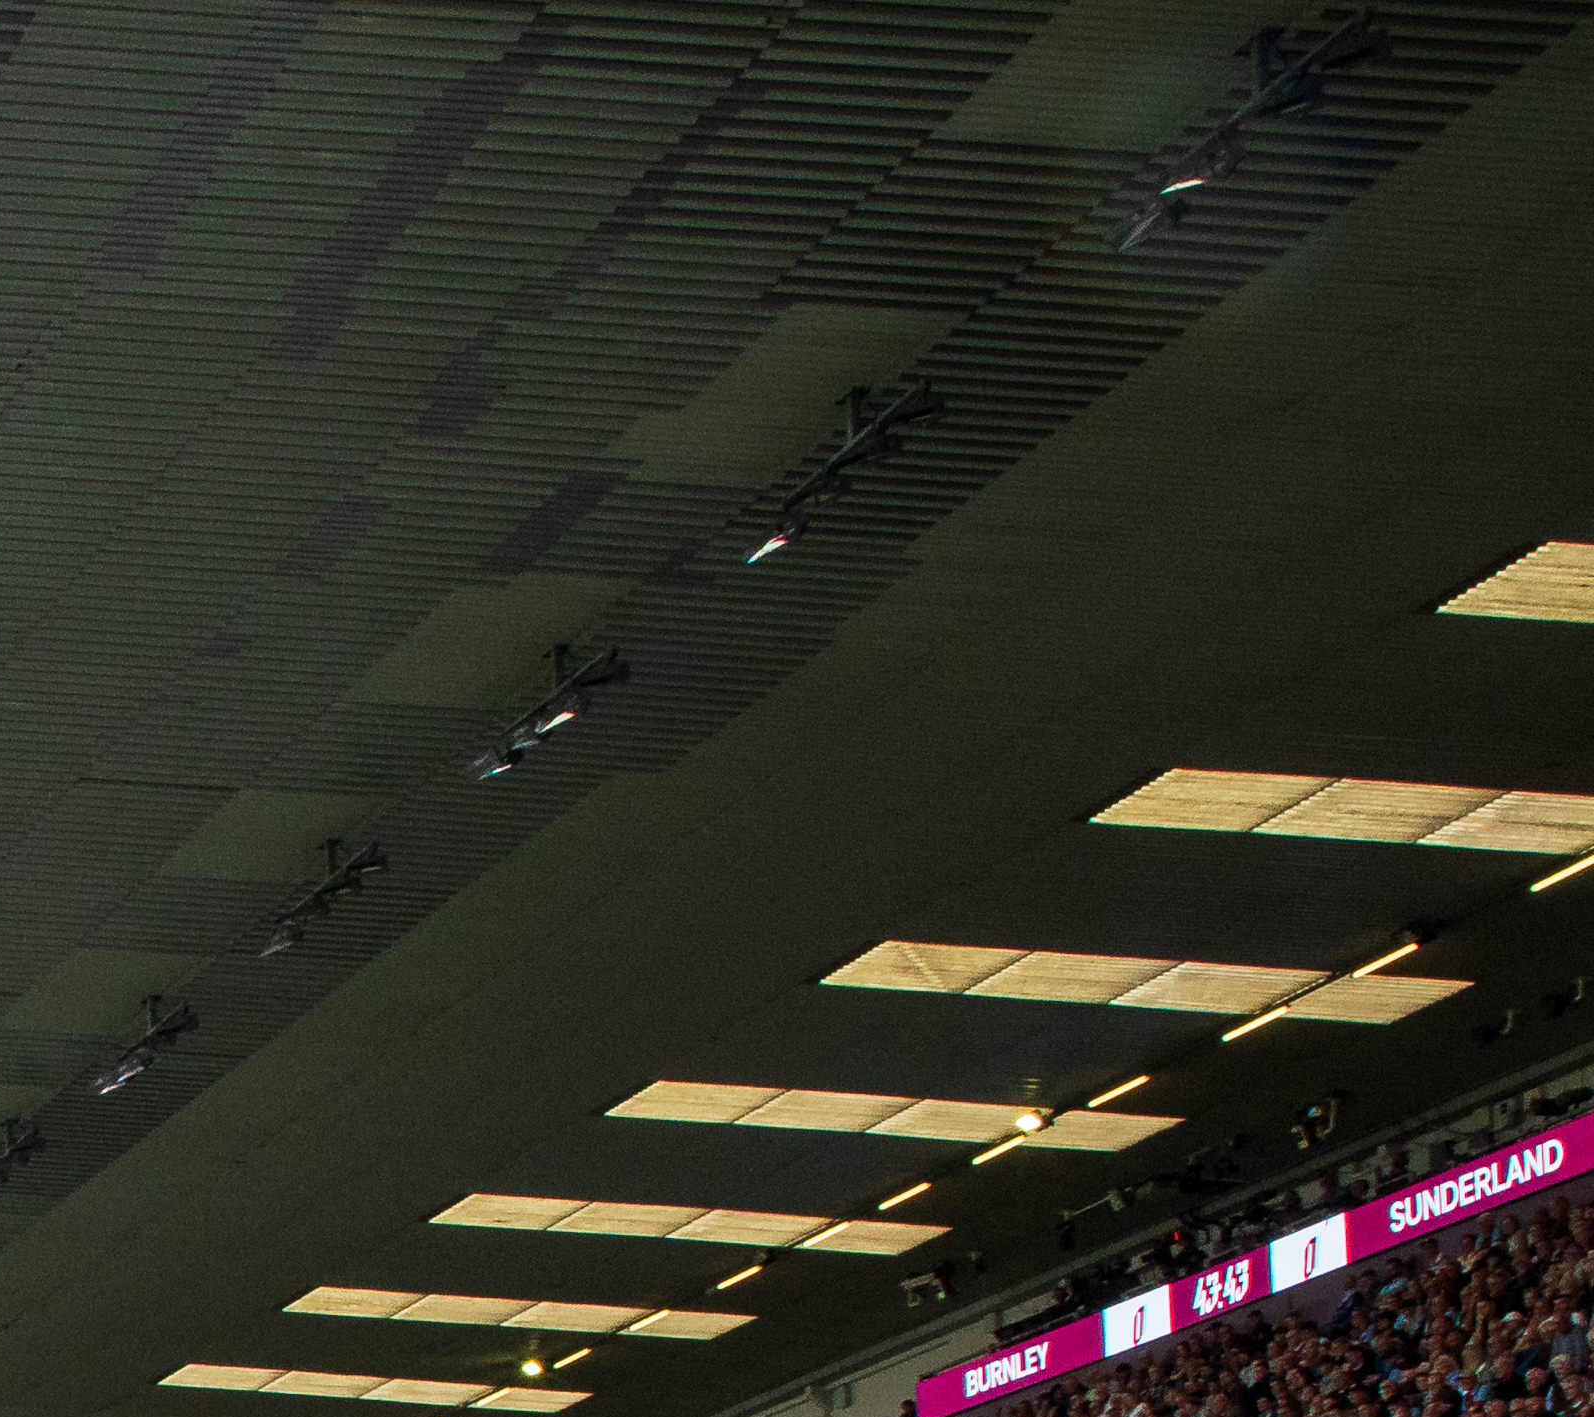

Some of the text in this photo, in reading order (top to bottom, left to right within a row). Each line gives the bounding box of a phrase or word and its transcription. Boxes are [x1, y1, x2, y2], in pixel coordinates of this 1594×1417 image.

[1389, 1136, 1565, 1234] SUNDERLAND
[1304, 1236, 1317, 1278] 0
[1192, 1259, 1250, 1317] 43:43
[1133, 1306, 1145, 1346] 0
[965, 1341, 1050, 1399] BURNLEY
